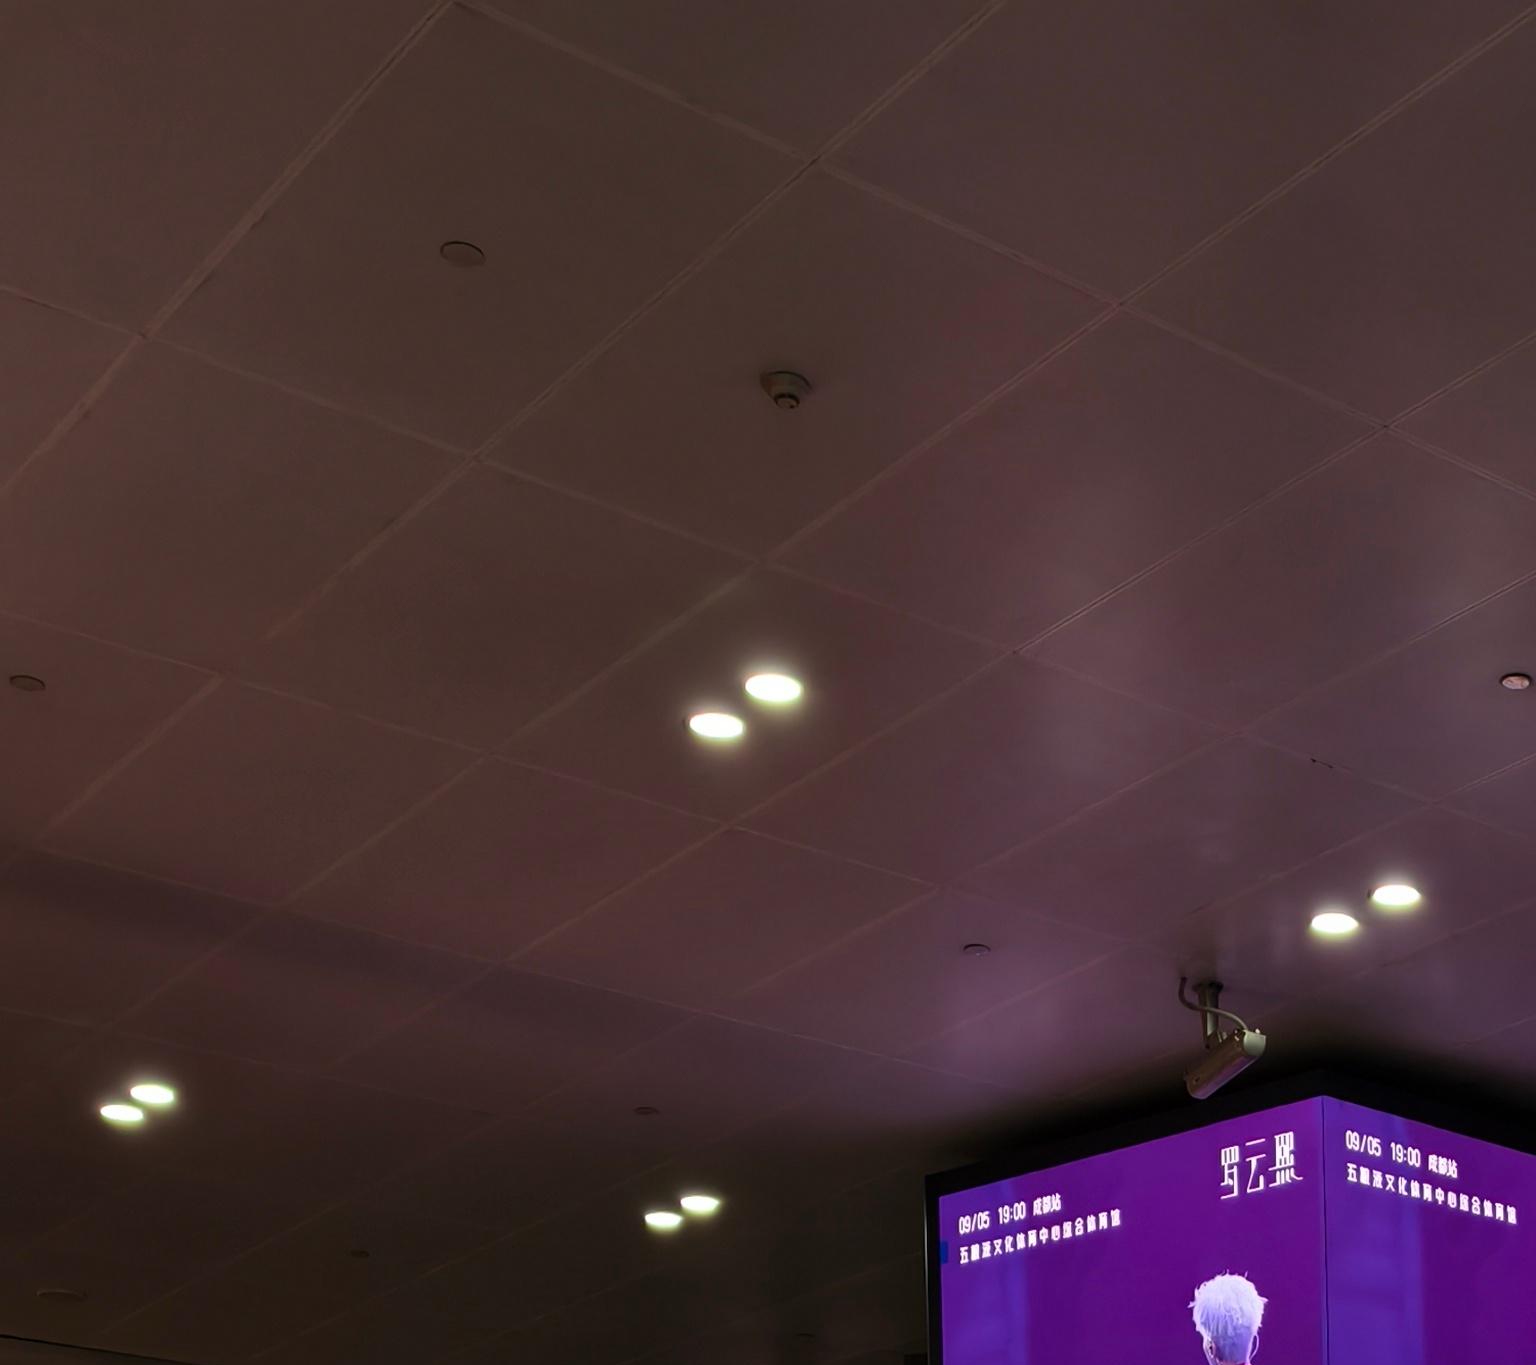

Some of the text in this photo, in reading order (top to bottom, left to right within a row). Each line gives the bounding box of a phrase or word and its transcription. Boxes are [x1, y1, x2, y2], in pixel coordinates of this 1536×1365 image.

[1345, 1130, 1382, 1157] 09/05
[1390, 1142, 1421, 1168] 19:00
[958, 1211, 990, 1235] 09/05
[998, 1201, 1027, 1224] 19:00
